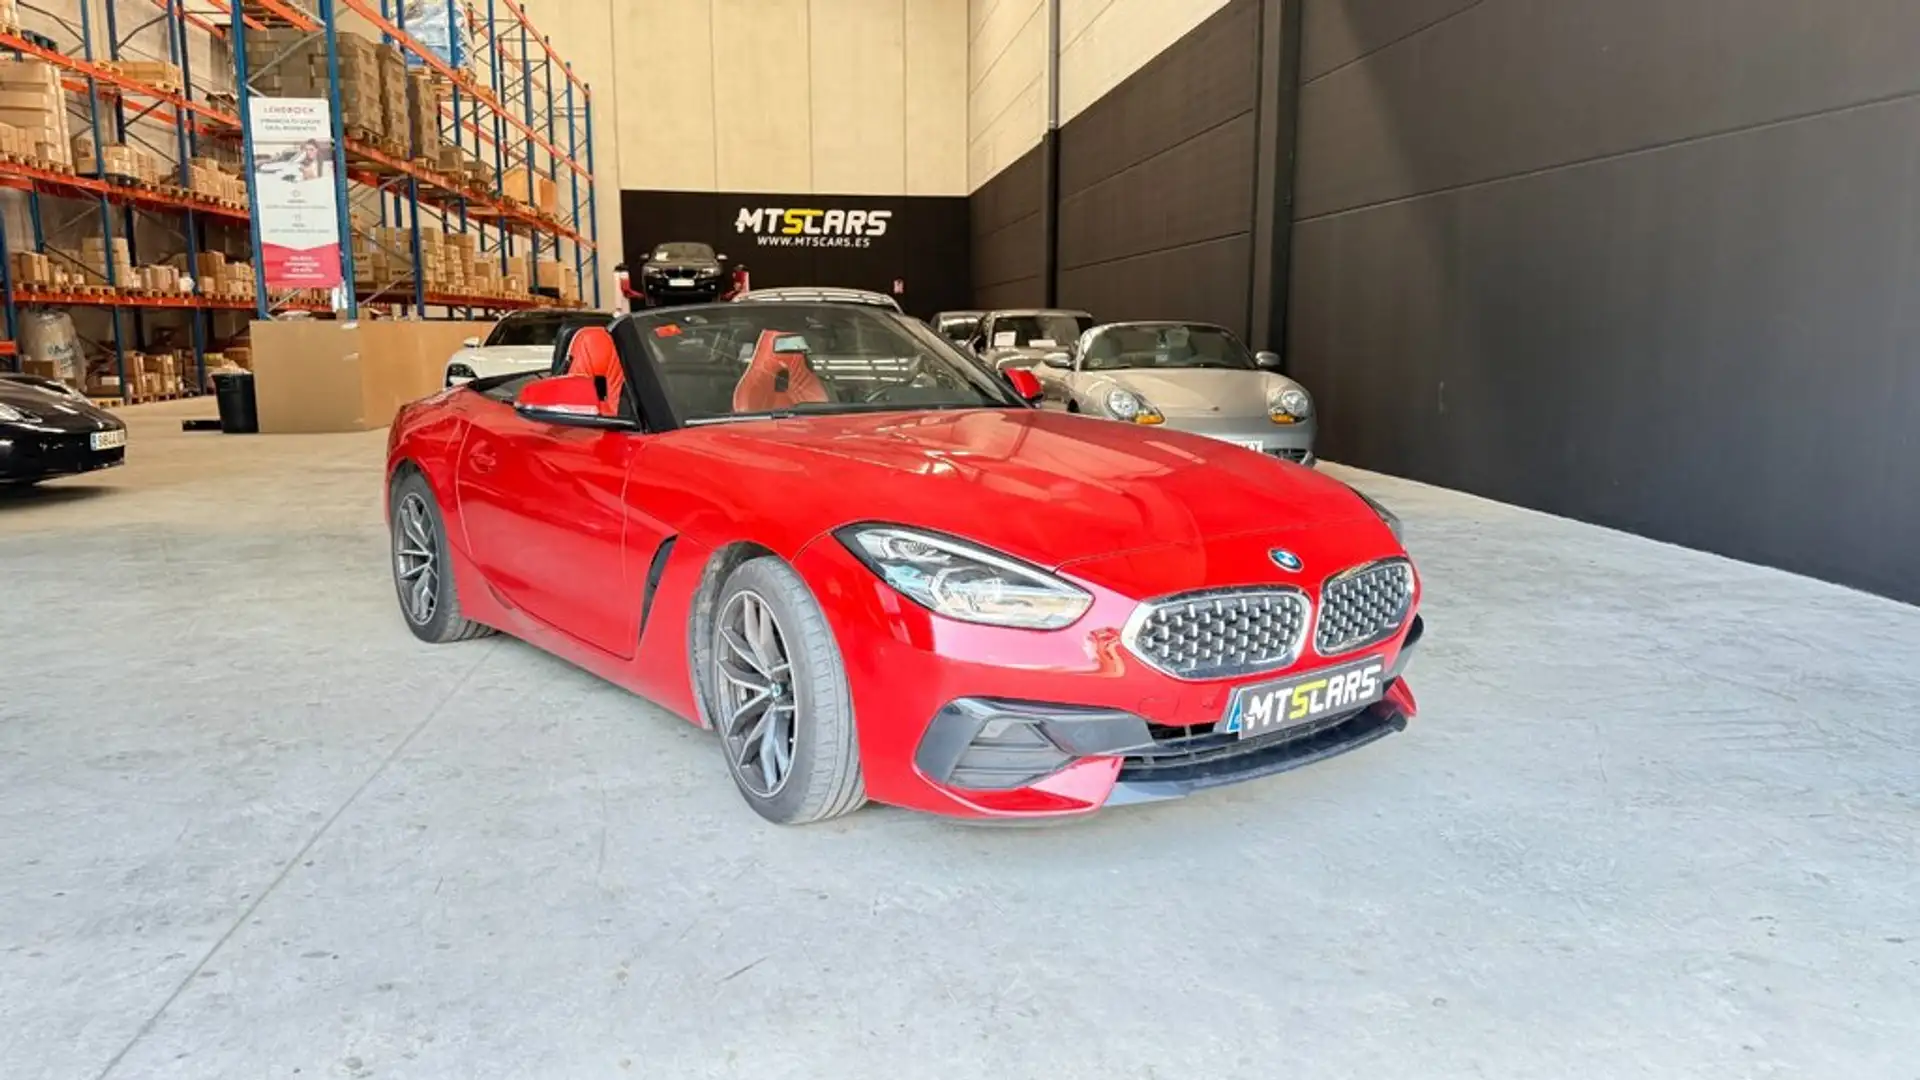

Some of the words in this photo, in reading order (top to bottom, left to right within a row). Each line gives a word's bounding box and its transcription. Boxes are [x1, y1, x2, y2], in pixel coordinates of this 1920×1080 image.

[735, 207, 892, 236] MTSCARS
[757, 236, 870, 248] WWW.MTSCARS.ES
[1243, 664, 1382, 730] MTSCARS
